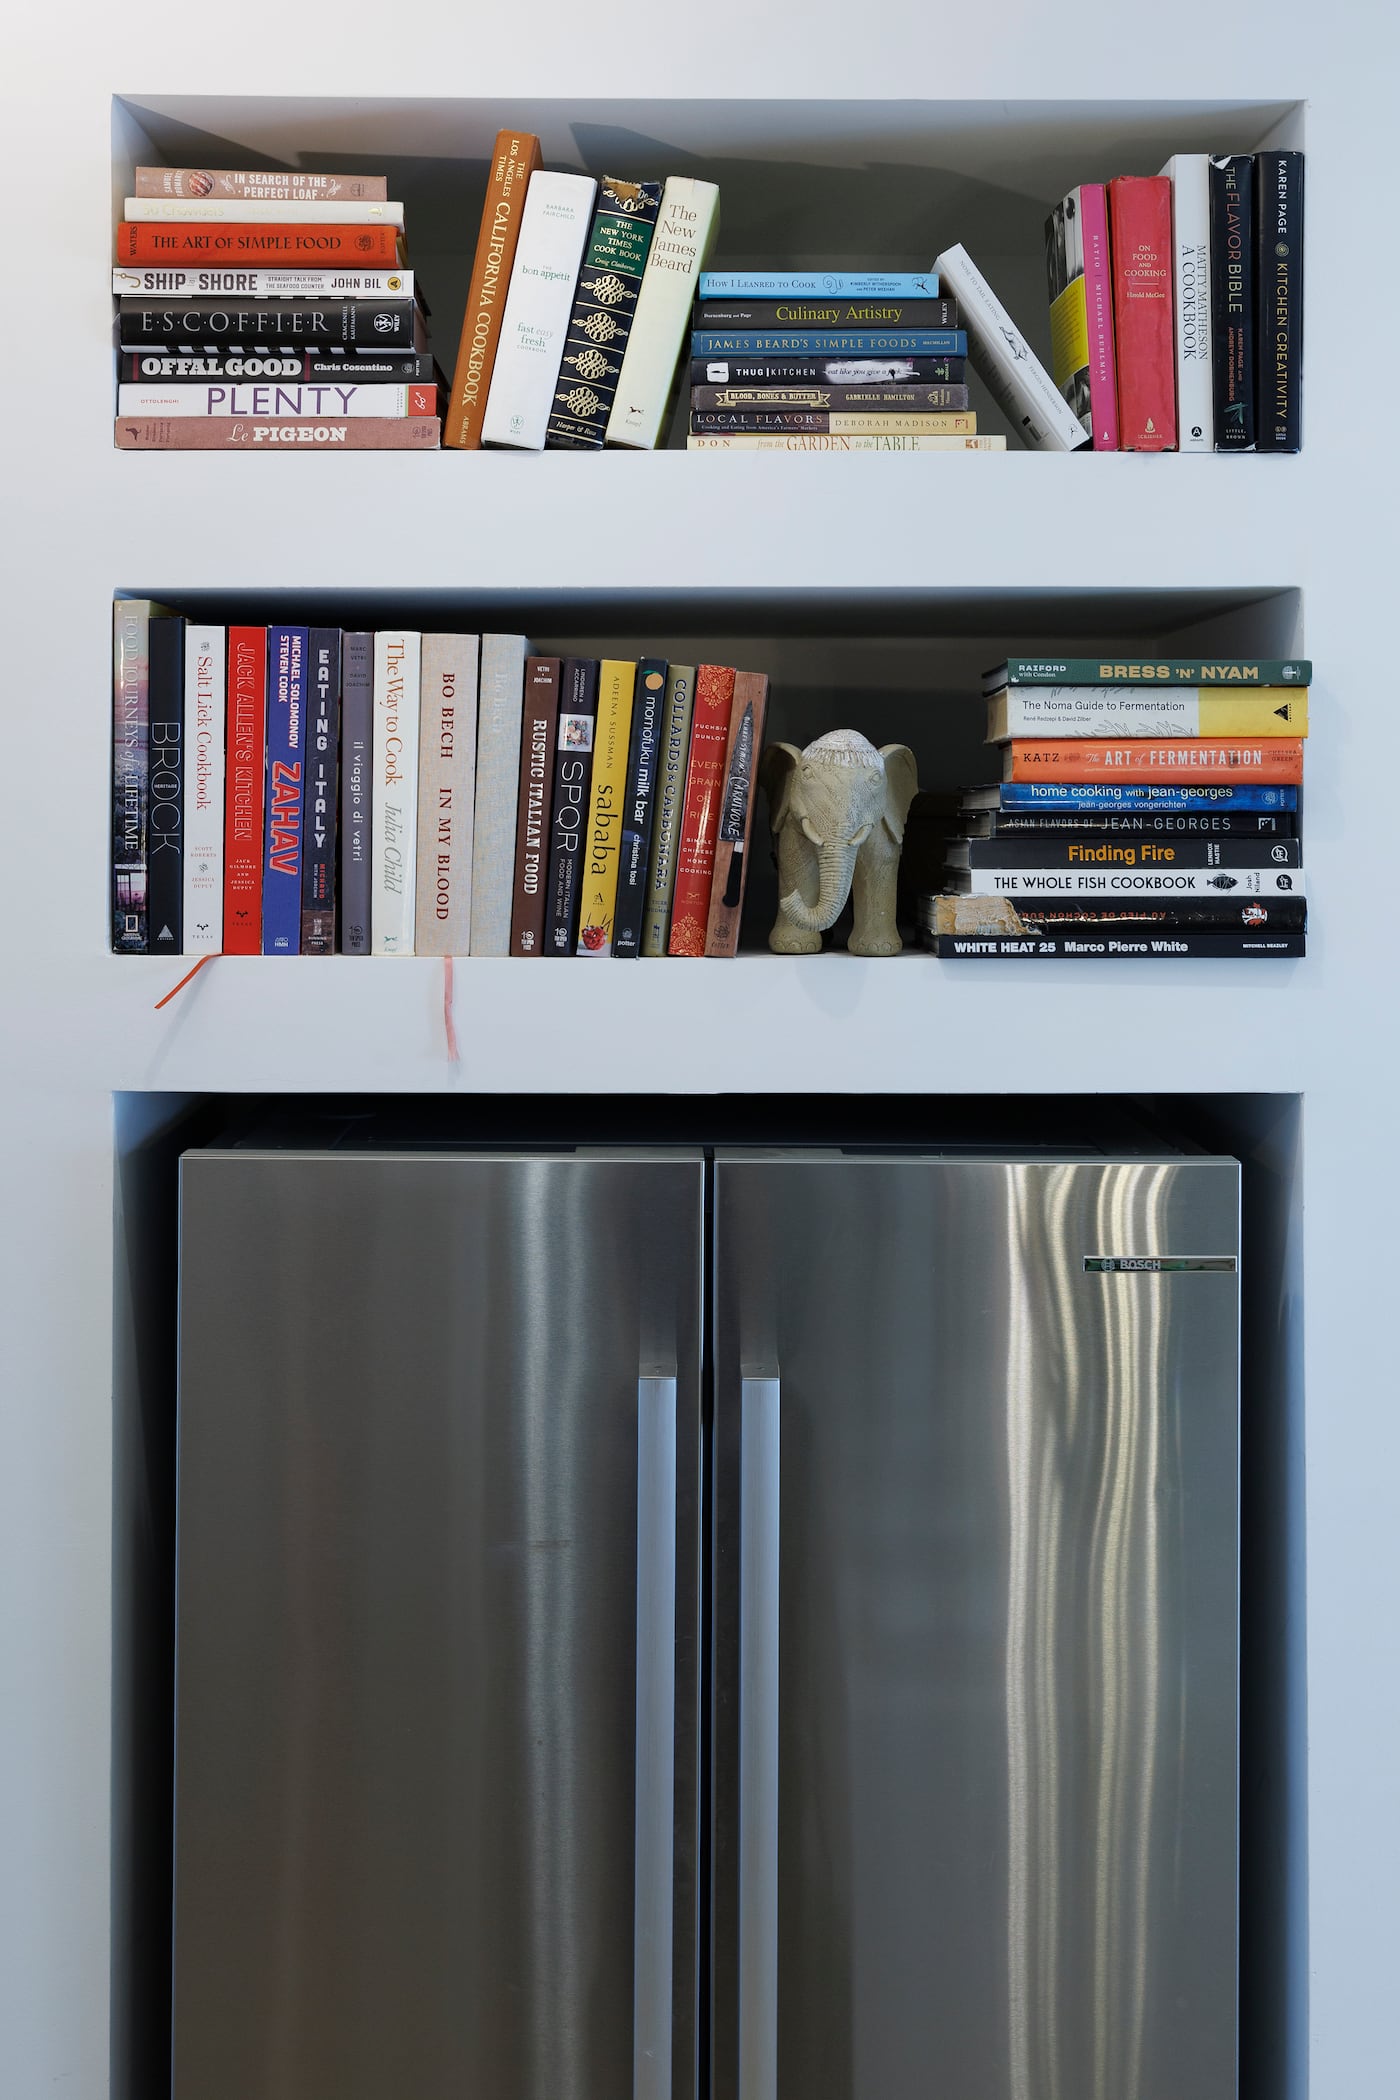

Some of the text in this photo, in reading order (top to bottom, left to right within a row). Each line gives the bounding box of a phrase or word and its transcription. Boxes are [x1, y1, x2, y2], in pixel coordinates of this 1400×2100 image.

[496, 156, 506, 181] TIMES
[503, 140, 519, 197] LOS ANGELES
[516, 162, 525, 179] THE
[235, 174, 327, 187] IN SEARCH OF THE
[244, 187, 317, 200] PERFECT LOAF
[1278, 160, 1288, 233] KAREN PAGE
[670, 204, 696, 221] The
[616, 221, 632, 230] THE
[662, 221, 696, 238] New
[608, 238, 632, 248] TIMES
[621, 231, 644, 242] YORK
[1225, 167, 1242, 313] THE FLAVOR BIBLE
[594, 245, 641, 261] COOK BOOK
[652, 237, 696, 257] James
[650, 254, 692, 274] Beard
[144, 273, 257, 290] SHIP SHORE
[331, 278, 381, 289] JOHN BIL
[462, 202, 511, 406] CALIFORNIA COOKBOOK
[1182, 245, 1196, 360] A COOKBOOK
[1197, 245, 1208, 360] MATTY MATHESON
[1276, 263, 1288, 326] KITCHEN
[776, 306, 902, 323] Culinary Artistry
[708, 339, 750, 350] JAMES
[756, 339, 809, 348] BEARD'S
[816, 339, 863, 348] SIMPLE
[871, 339, 917, 348] FOODS
[142, 358, 223, 375] OFFAL
[225, 358, 302, 376] GOOD
[1275, 332, 1288, 418] CREATIVITY
[208, 388, 358, 414] PLENTY
[697, 415, 823, 423] LOCAL FLAVORS
[227, 424, 347, 442] Le PIGEON
[757, 440, 773, 449] from
[774, 440, 784, 448] the
[787, 436, 850, 450] GARDEN
[863, 440, 873, 448] the
[872, 437, 920, 451] TABLE
[278, 635, 289, 702] STEVEN COOK
[1100, 665, 1170, 678] BRESS
[1201, 666, 1259, 679] NYAM
[289, 636, 301, 748] MICHAEL SOLOMONOV
[380, 638, 405, 786] The Way to Cook
[1022, 701, 1041, 710] The
[1044, 701, 1072, 710] Noma
[1075, 701, 1104, 710] Guide
[1120, 702, 1185, 711] Fermentation
[606, 676, 620, 769] ADEENA SUSSMAN
[196, 656, 213, 811] Salt Lick Cookbook
[314, 650, 329, 848] EATING ITALY
[1024, 753, 1059, 762] KATZ
[634, 697, 656, 824] momofuku milk bar
[152, 722, 181, 854] BROCK
[351, 756, 364, 804] viaggio
[436, 673, 455, 920] BO BECH IN MY BLOOD
[1031, 785, 1067, 796] home
[1071, 785, 1121, 799] cooking
[1148, 786, 1233, 799] jean-georges
[524, 720, 547, 894] RUSTIC ITALIAN FOOD
[555, 761, 584, 852] SPQR
[1078, 801, 1186, 809] jean-georges vongerichten
[270, 760, 301, 875] ZAHAV
[353, 812, 363, 823] di
[353, 830, 362, 861] vetri
[1068, 844, 1175, 865] Finding Fire
[680, 867, 711, 875] COOKING
[994, 877, 1196, 888] THE WHOLE FISH COOKBOOK
[954, 942, 1188, 952] WHITE HEAT 25 Marco Pierre White
[1120, 1260, 1160, 1270] BOSCH
